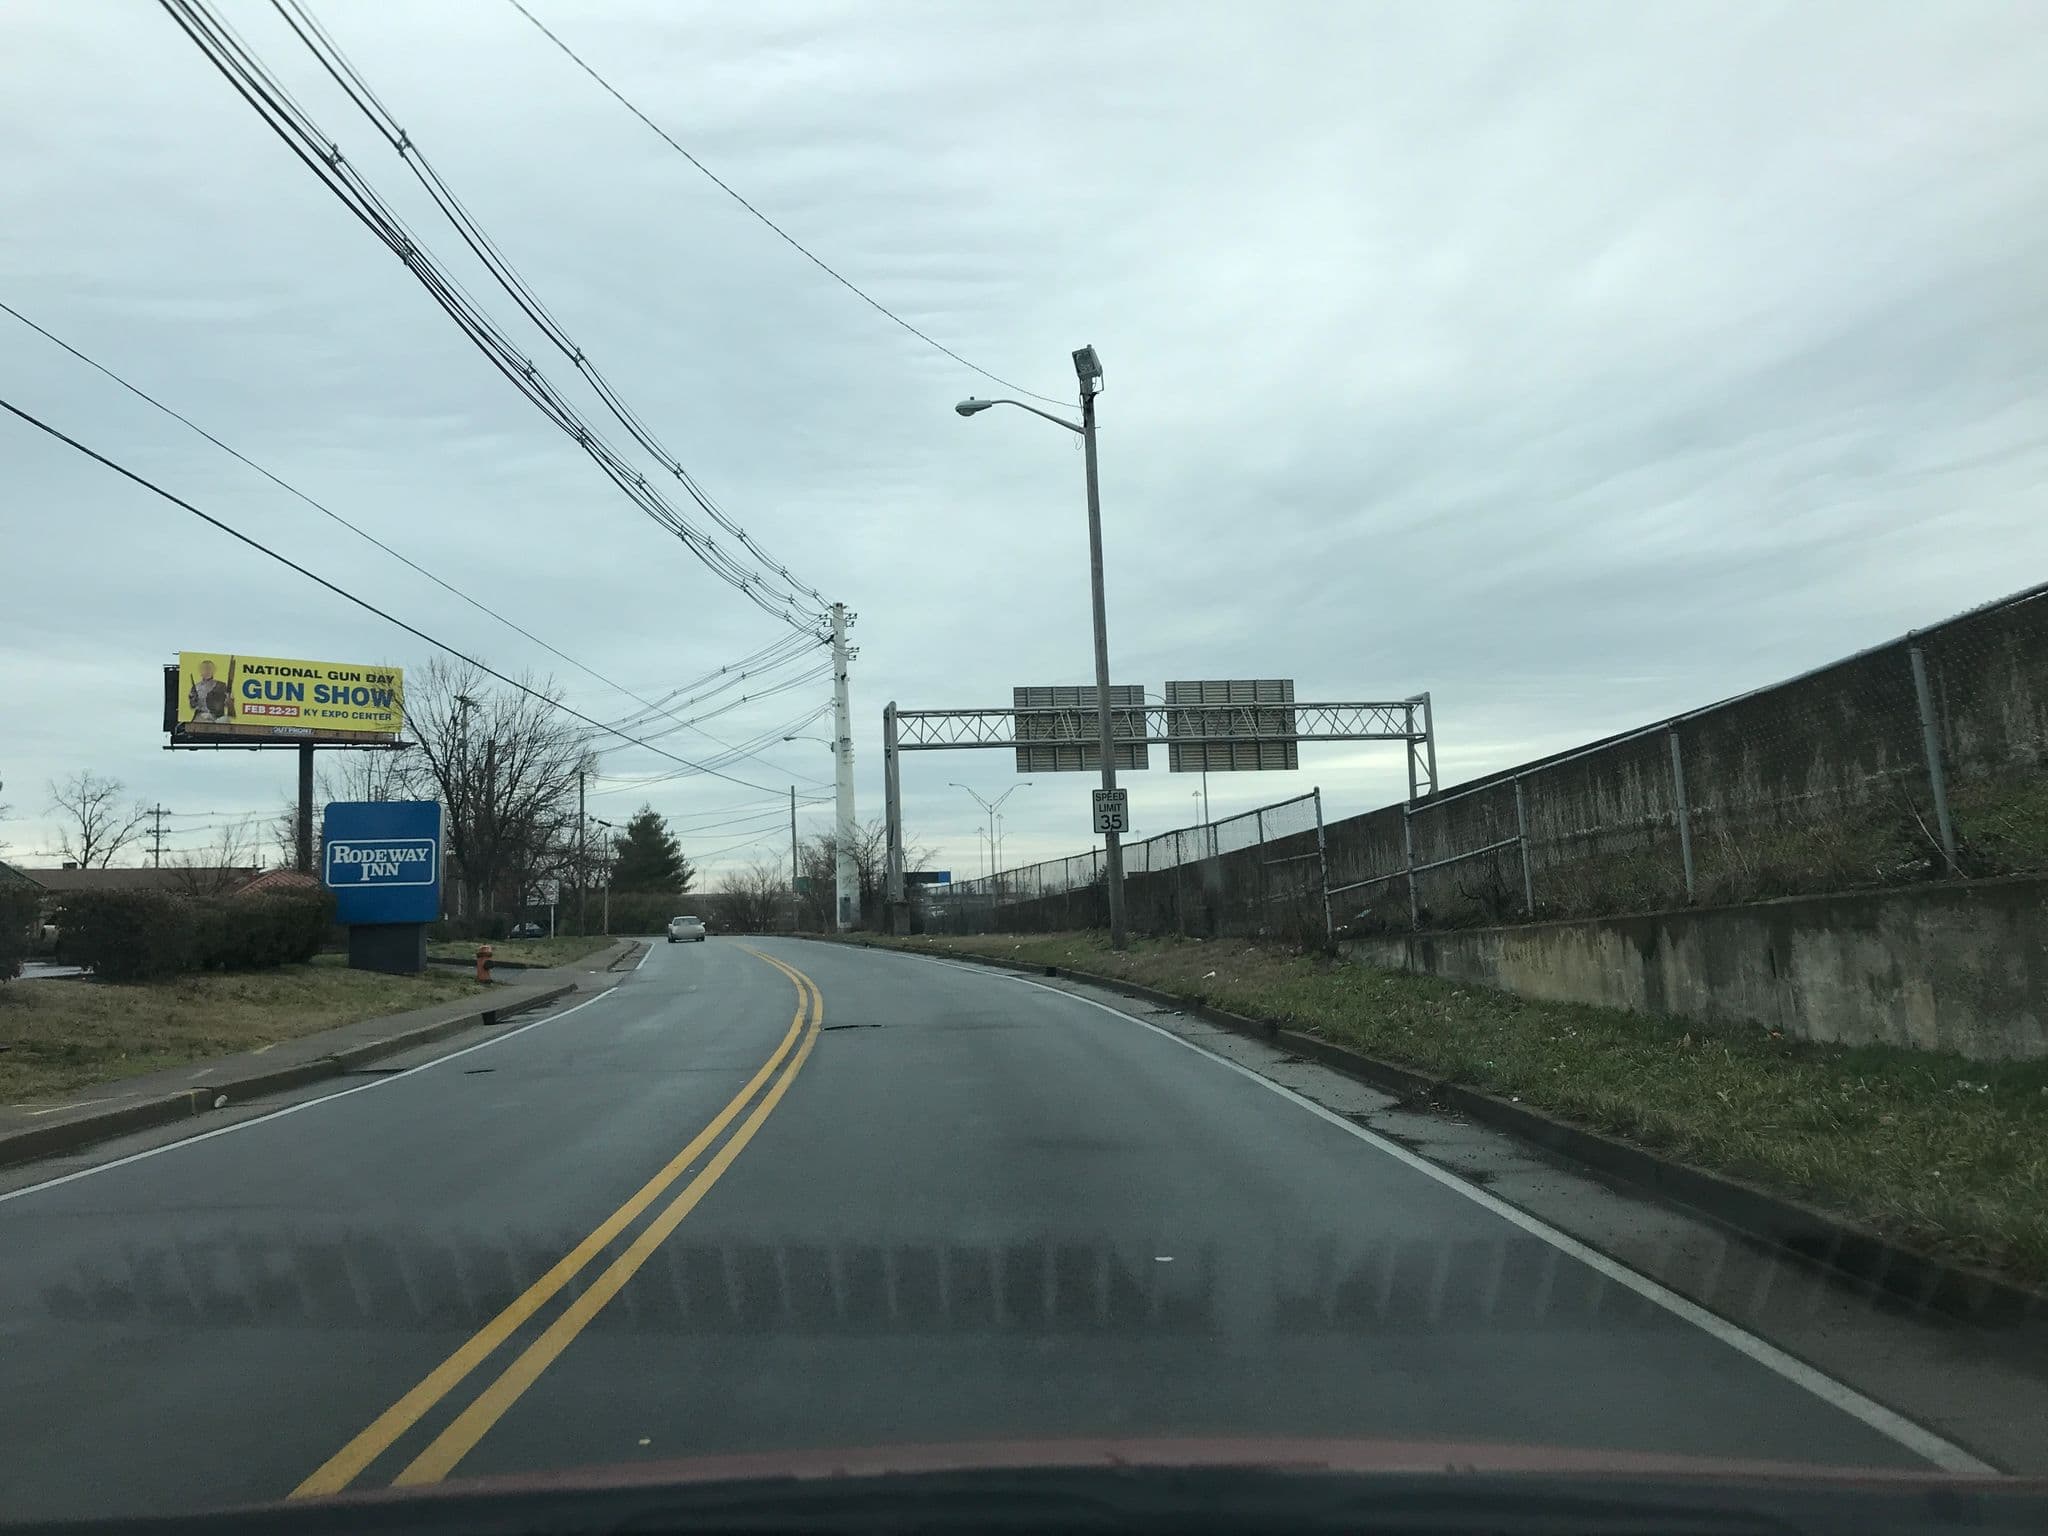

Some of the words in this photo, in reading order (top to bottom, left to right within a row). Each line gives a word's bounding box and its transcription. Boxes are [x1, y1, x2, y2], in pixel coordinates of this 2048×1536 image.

[242, 664, 323, 679] NATIONAL
[327, 671, 361, 682] GUN
[366, 674, 395, 684] DAY
[242, 679, 305, 702] GUN
[313, 684, 394, 707] SHOW
[244, 705, 266, 714] FEB
[268, 706, 298, 716] 22-23
[304, 709, 318, 717] KY
[321, 710, 349, 719] EXPO
[352, 711, 392, 721] CENTER
[1096, 792, 1125, 801] SPEED
[1099, 804, 1122, 812] LIMIT
[1101, 815, 1122, 829] 35
[333, 846, 430, 863] RODEWAY
[360, 863, 400, 881] INN
